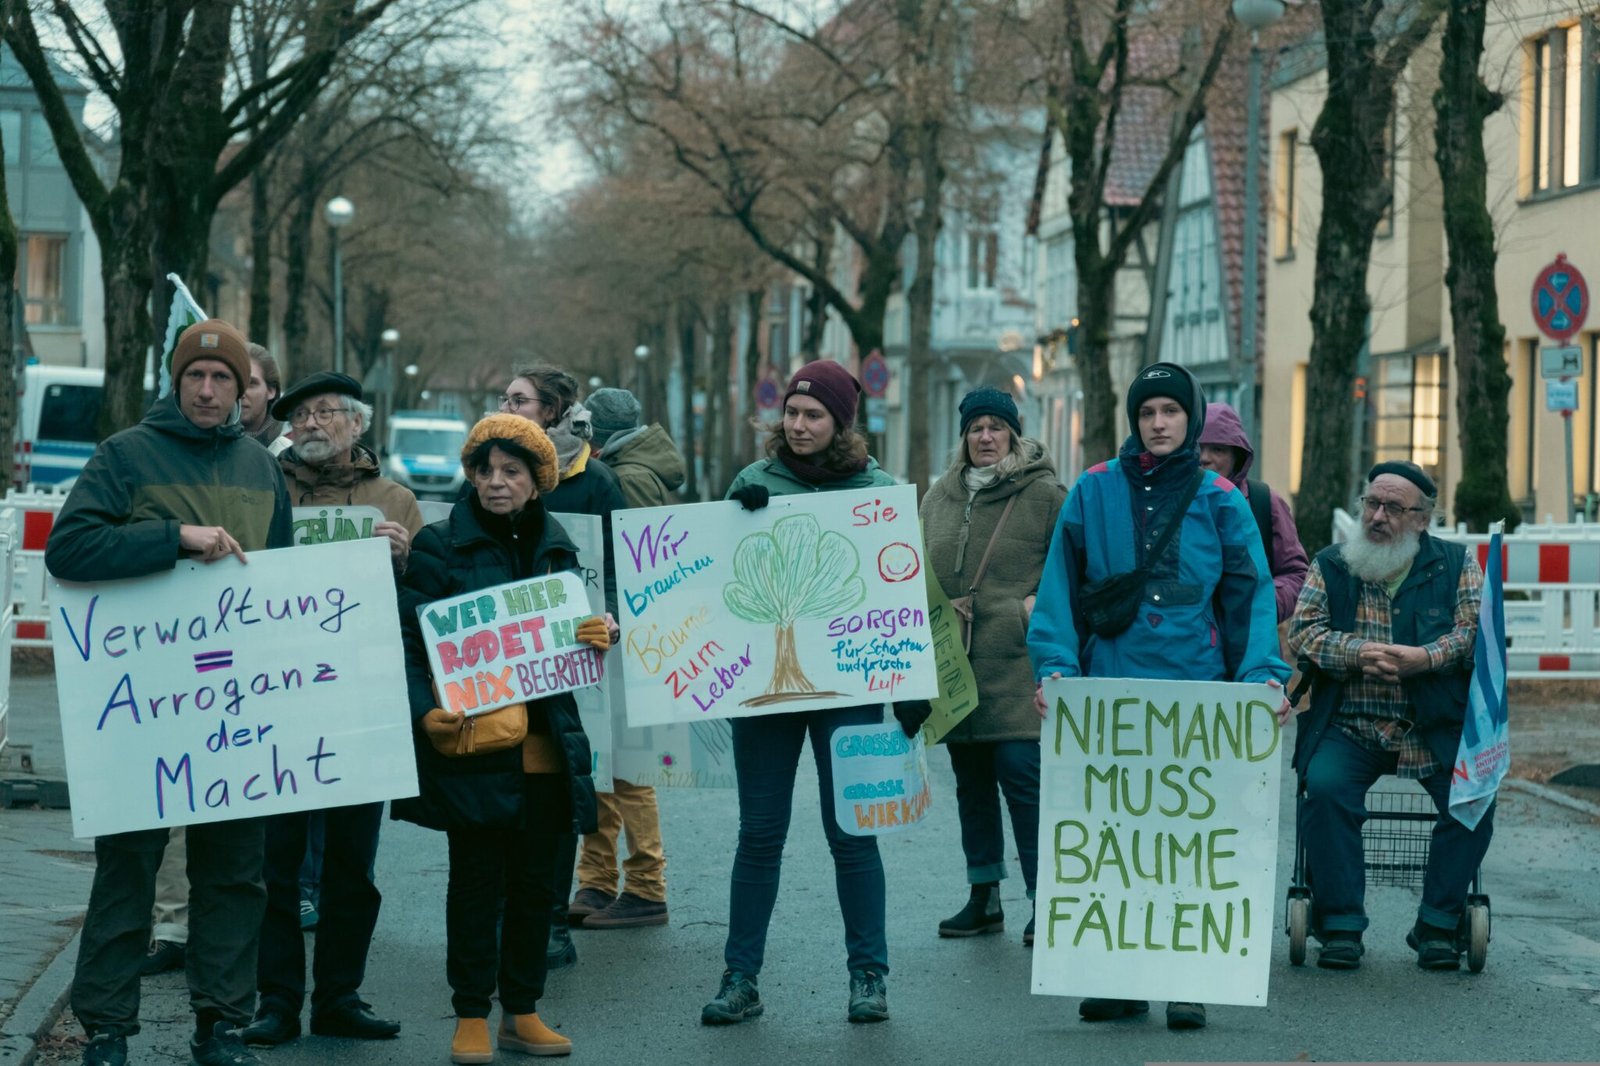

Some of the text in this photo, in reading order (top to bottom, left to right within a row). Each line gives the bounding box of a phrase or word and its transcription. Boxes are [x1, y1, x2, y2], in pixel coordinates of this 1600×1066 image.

[852, 499, 898, 526] Sie
[622, 514, 689, 573] Wir
[624, 555, 714, 617] brauchen
[60, 586, 360, 661] Verwaltung
[426, 595, 497, 637] WER
[436, 616, 546, 675] RODET
[97, 663, 338, 731] Arroganz
[868, 672, 906, 697] Luft
[206, 719, 273, 752] der
[1055, 696, 1279, 761] NIEMAND
[156, 736, 341, 819] Macht
[843, 779, 905, 800] GROSSE
[1085, 764, 1216, 819] MUSS
[1055, 819, 1239, 891] BÄUME
[1048, 892, 1250, 957] FÄLLEN!
